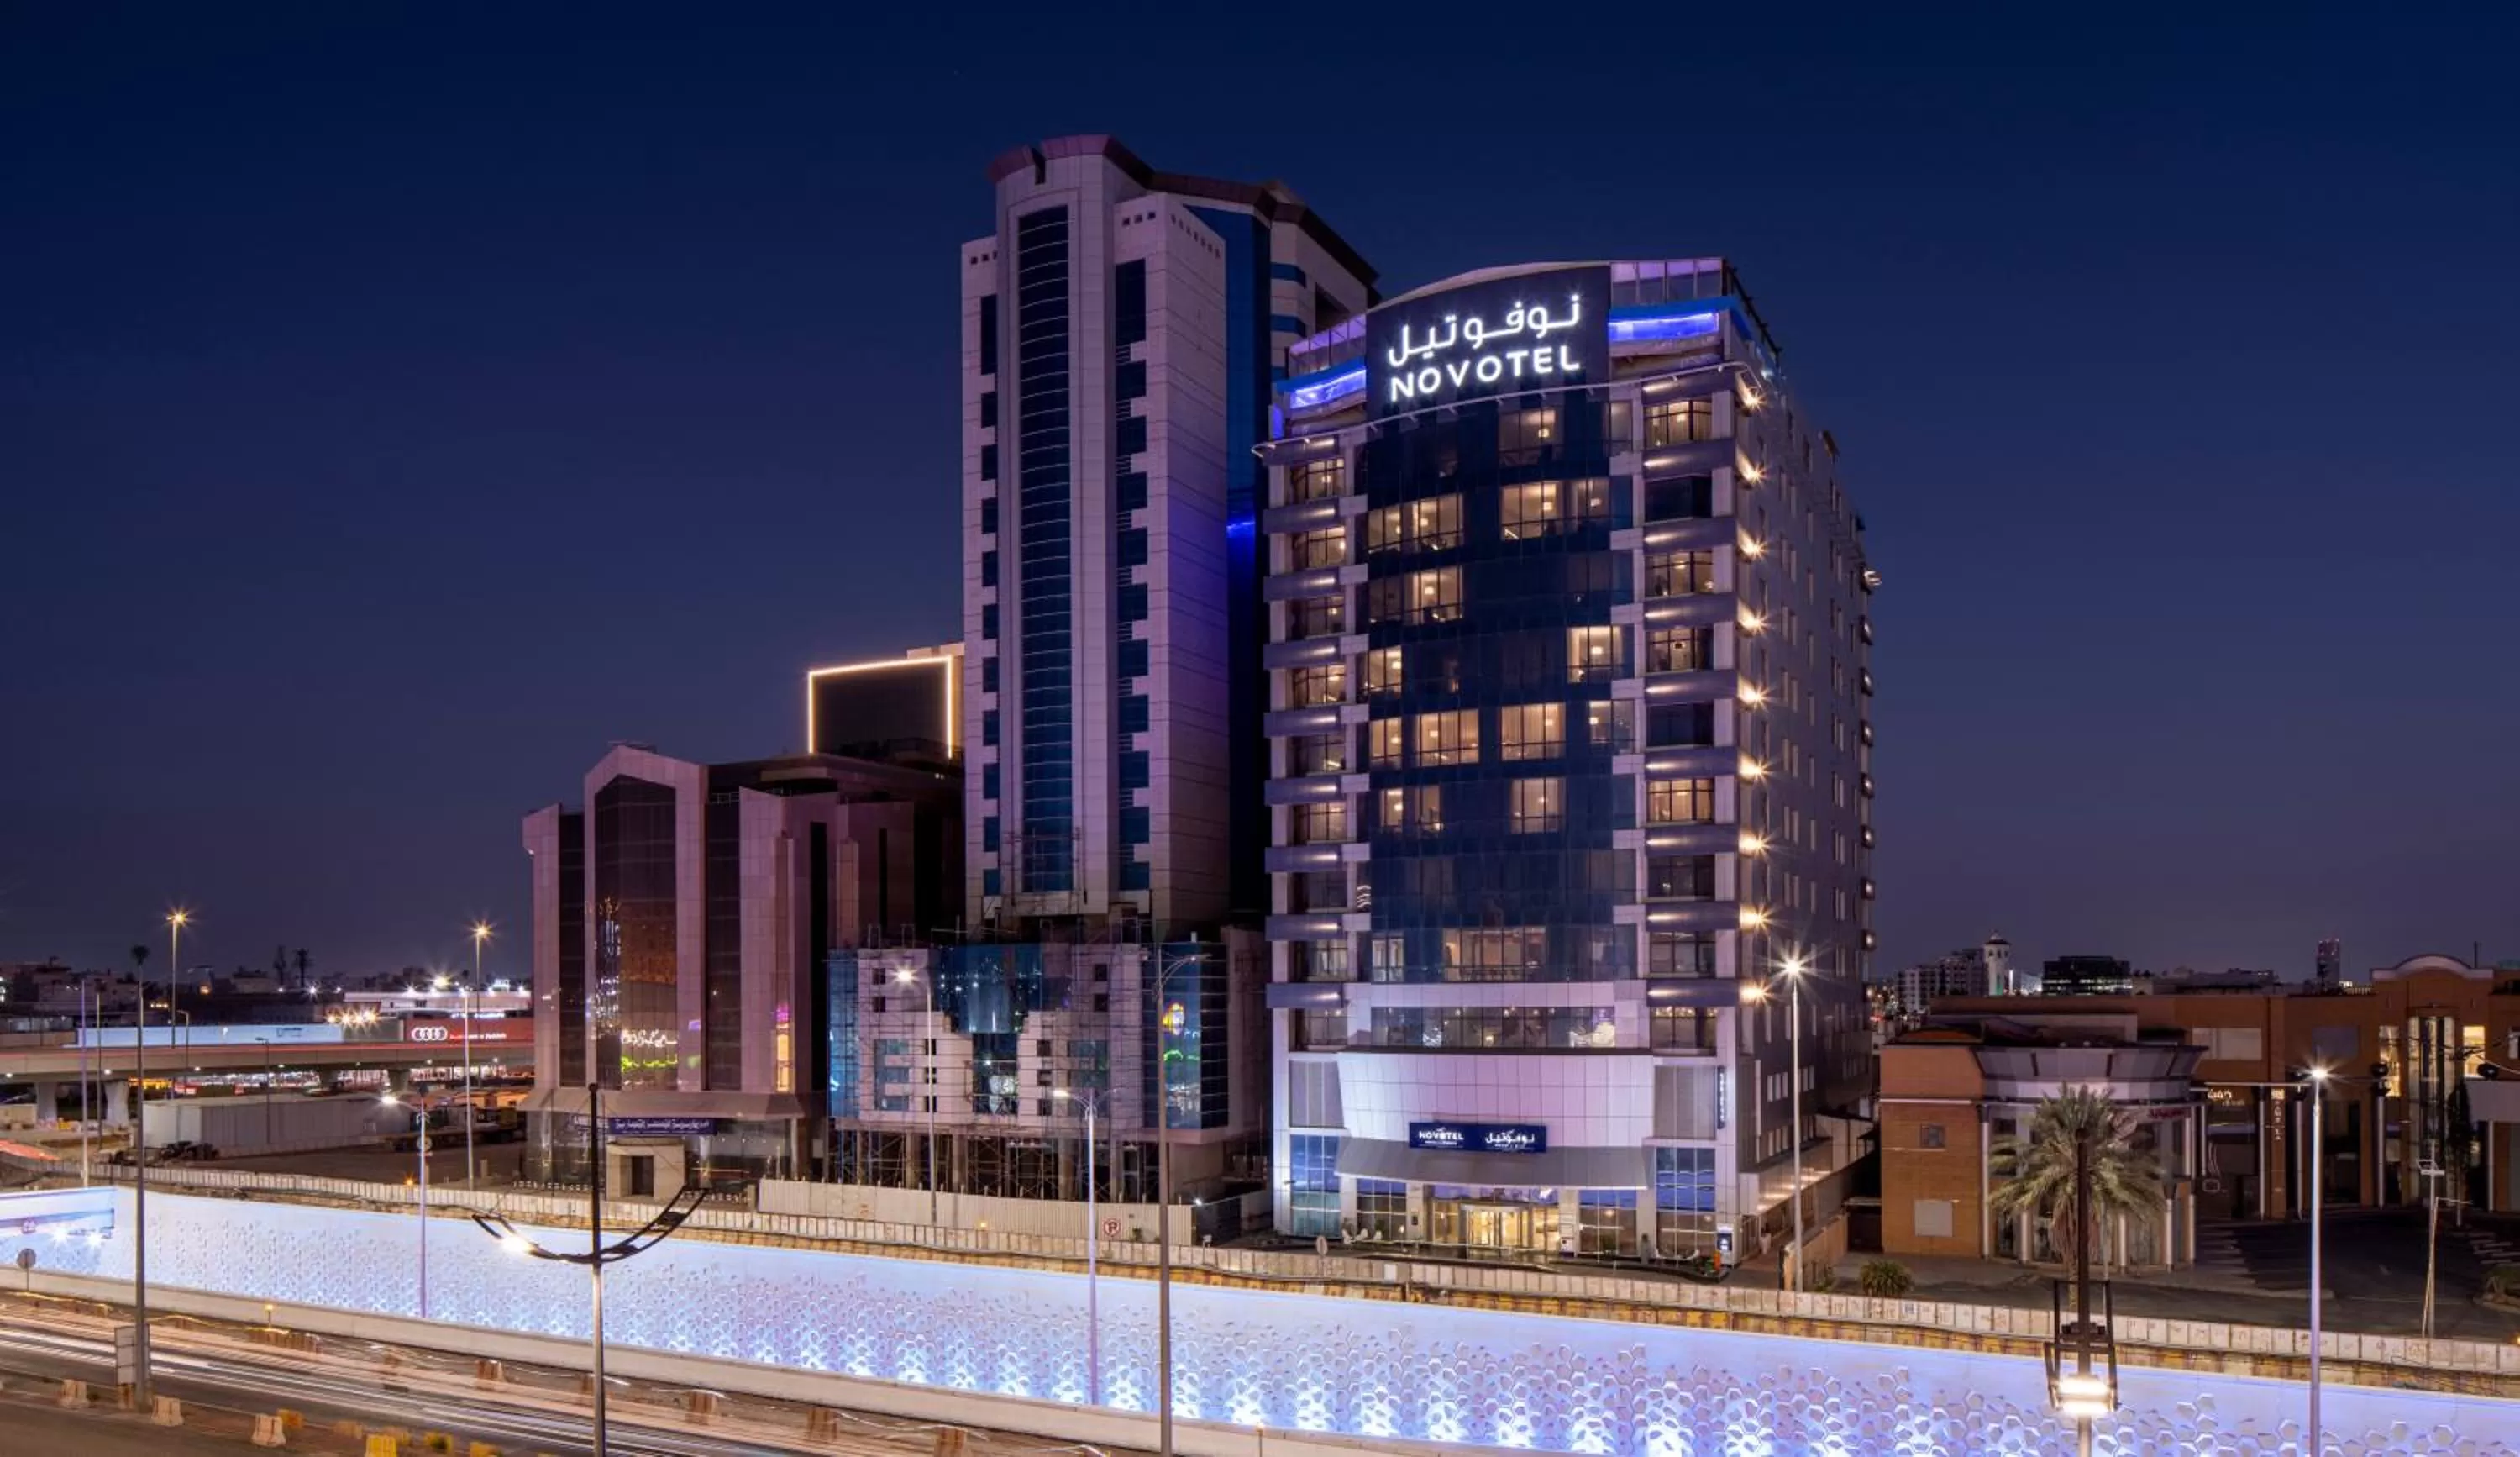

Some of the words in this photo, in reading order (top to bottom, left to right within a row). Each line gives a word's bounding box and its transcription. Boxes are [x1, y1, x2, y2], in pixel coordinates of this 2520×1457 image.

[1388, 293, 1581, 367] نوفوتيل
[1390, 344, 1581, 402] NOVOTEL
[1418, 1130, 1465, 1141] NOVOTEL
